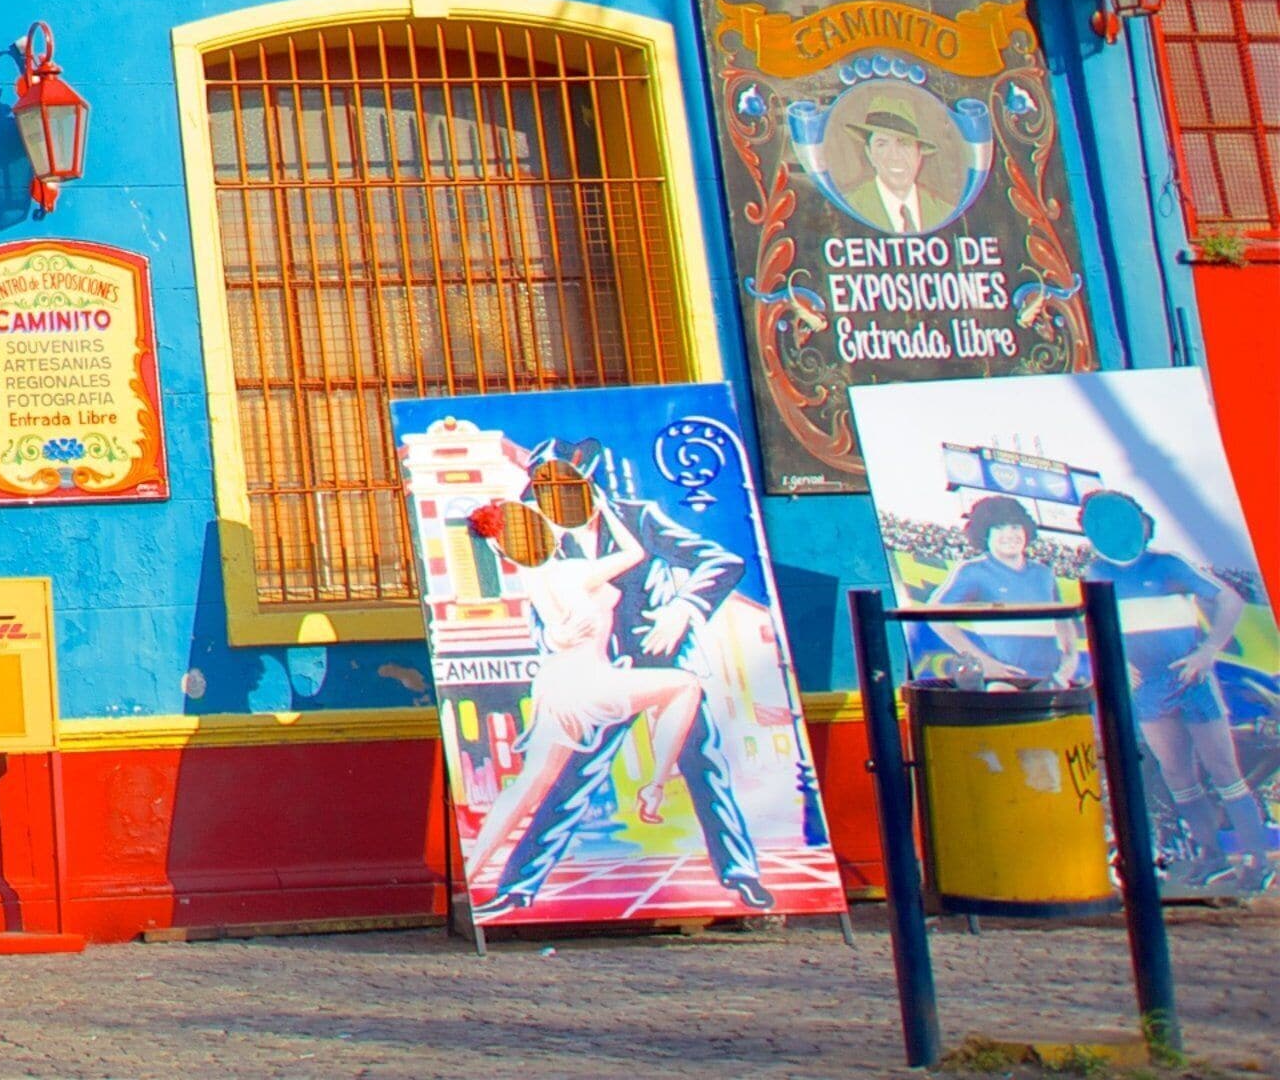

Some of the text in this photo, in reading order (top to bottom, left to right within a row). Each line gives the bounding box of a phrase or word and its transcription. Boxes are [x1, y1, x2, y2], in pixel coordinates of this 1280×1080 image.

[795, 6, 960, 61] CAMINITO
[824, 235, 1002, 268] CENTRO DE
[28, 277, 39, 291] de
[42, 272, 120, 303] EXPOSICIONES
[829, 273, 1009, 314] EXPOSICIONES
[6, 339, 104, 354] SOUVENIRS
[837, 318, 1017, 363] Entrada libre
[3, 356, 112, 372] ARTESANIAS
[5, 374, 111, 389] REGIONALES
[7, 392, 115, 408] FOTOGRAFIA
[9, 411, 117, 427] Entrada Libre
